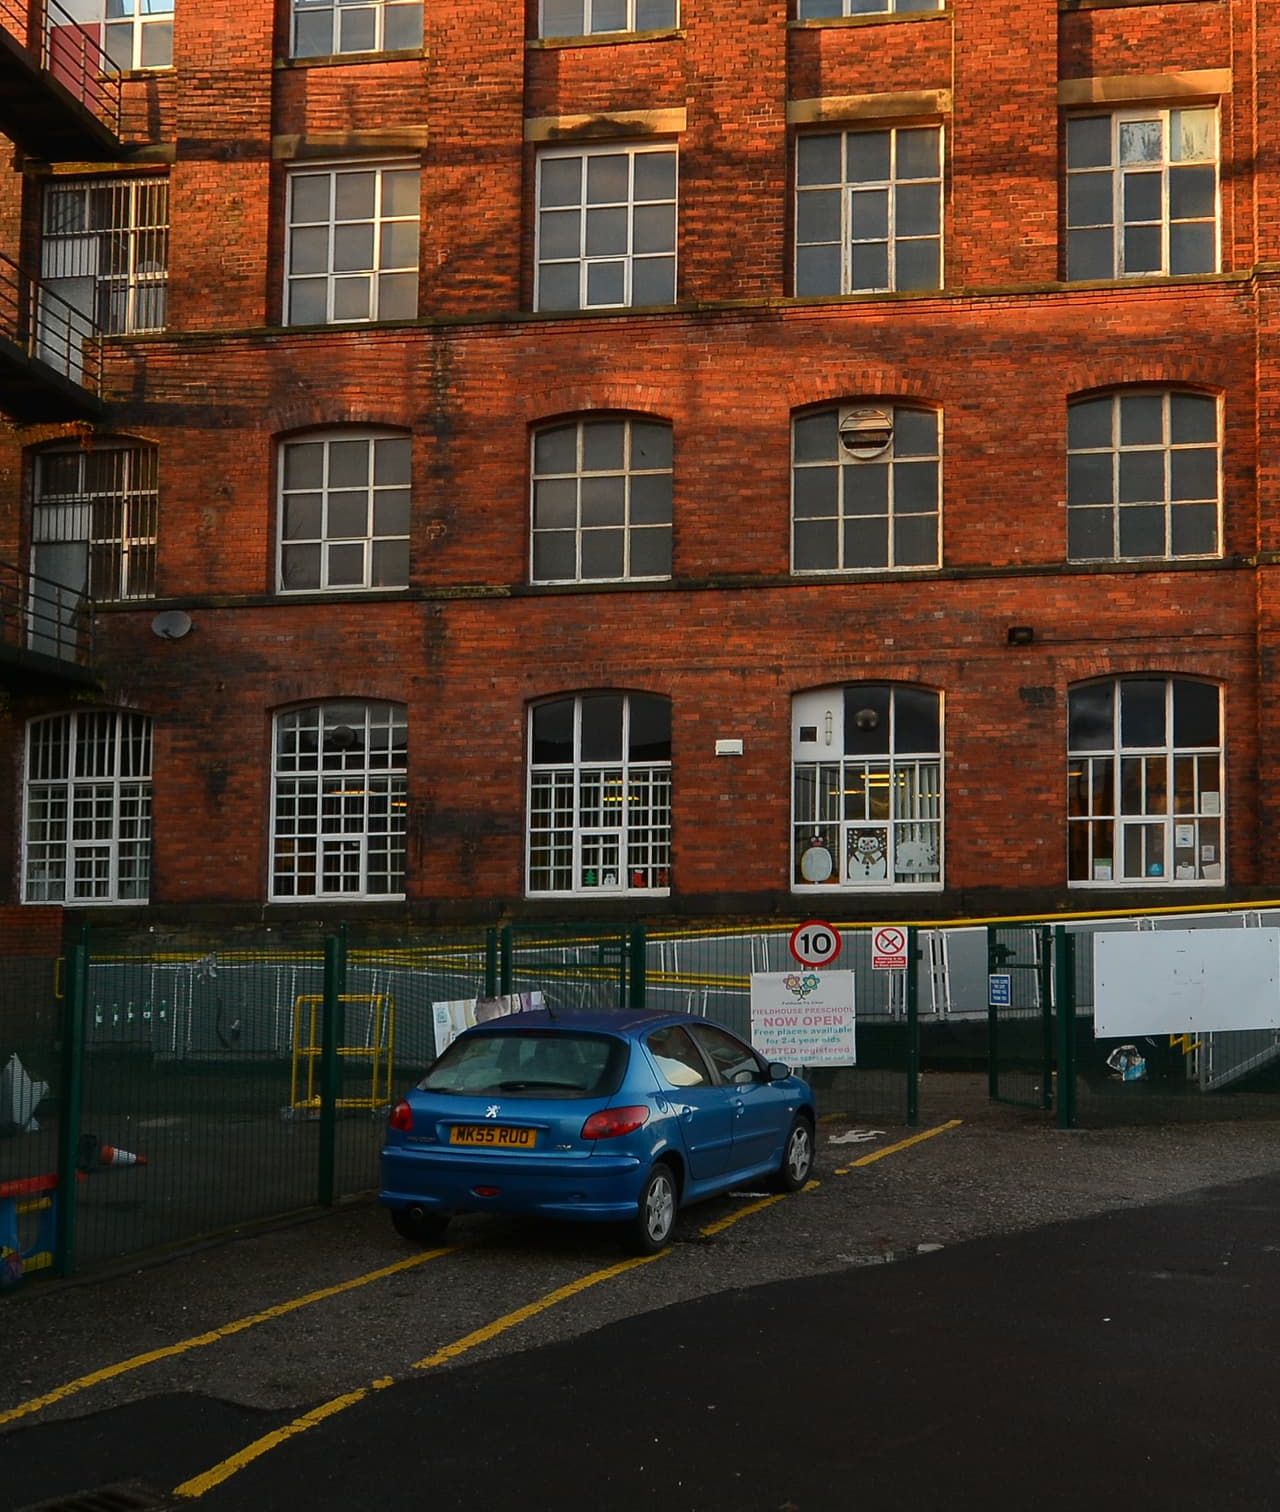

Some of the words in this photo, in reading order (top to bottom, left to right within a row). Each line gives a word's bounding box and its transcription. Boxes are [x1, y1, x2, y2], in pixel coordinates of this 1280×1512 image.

[800, 933, 832, 954] 10
[752, 1008, 804, 1016] FIELDHOUSE
[805, 1006, 854, 1015] PRESCHOOL
[763, 1017, 798, 1027] NOW
[802, 1015, 843, 1026] OPEN
[777, 1028, 808, 1038] places
[810, 1026, 853, 1035] available
[766, 1037, 779, 1045] for
[798, 1038, 819, 1046] year
[800, 1047, 850, 1056] registered
[456, 1127, 495, 1143] MK55
